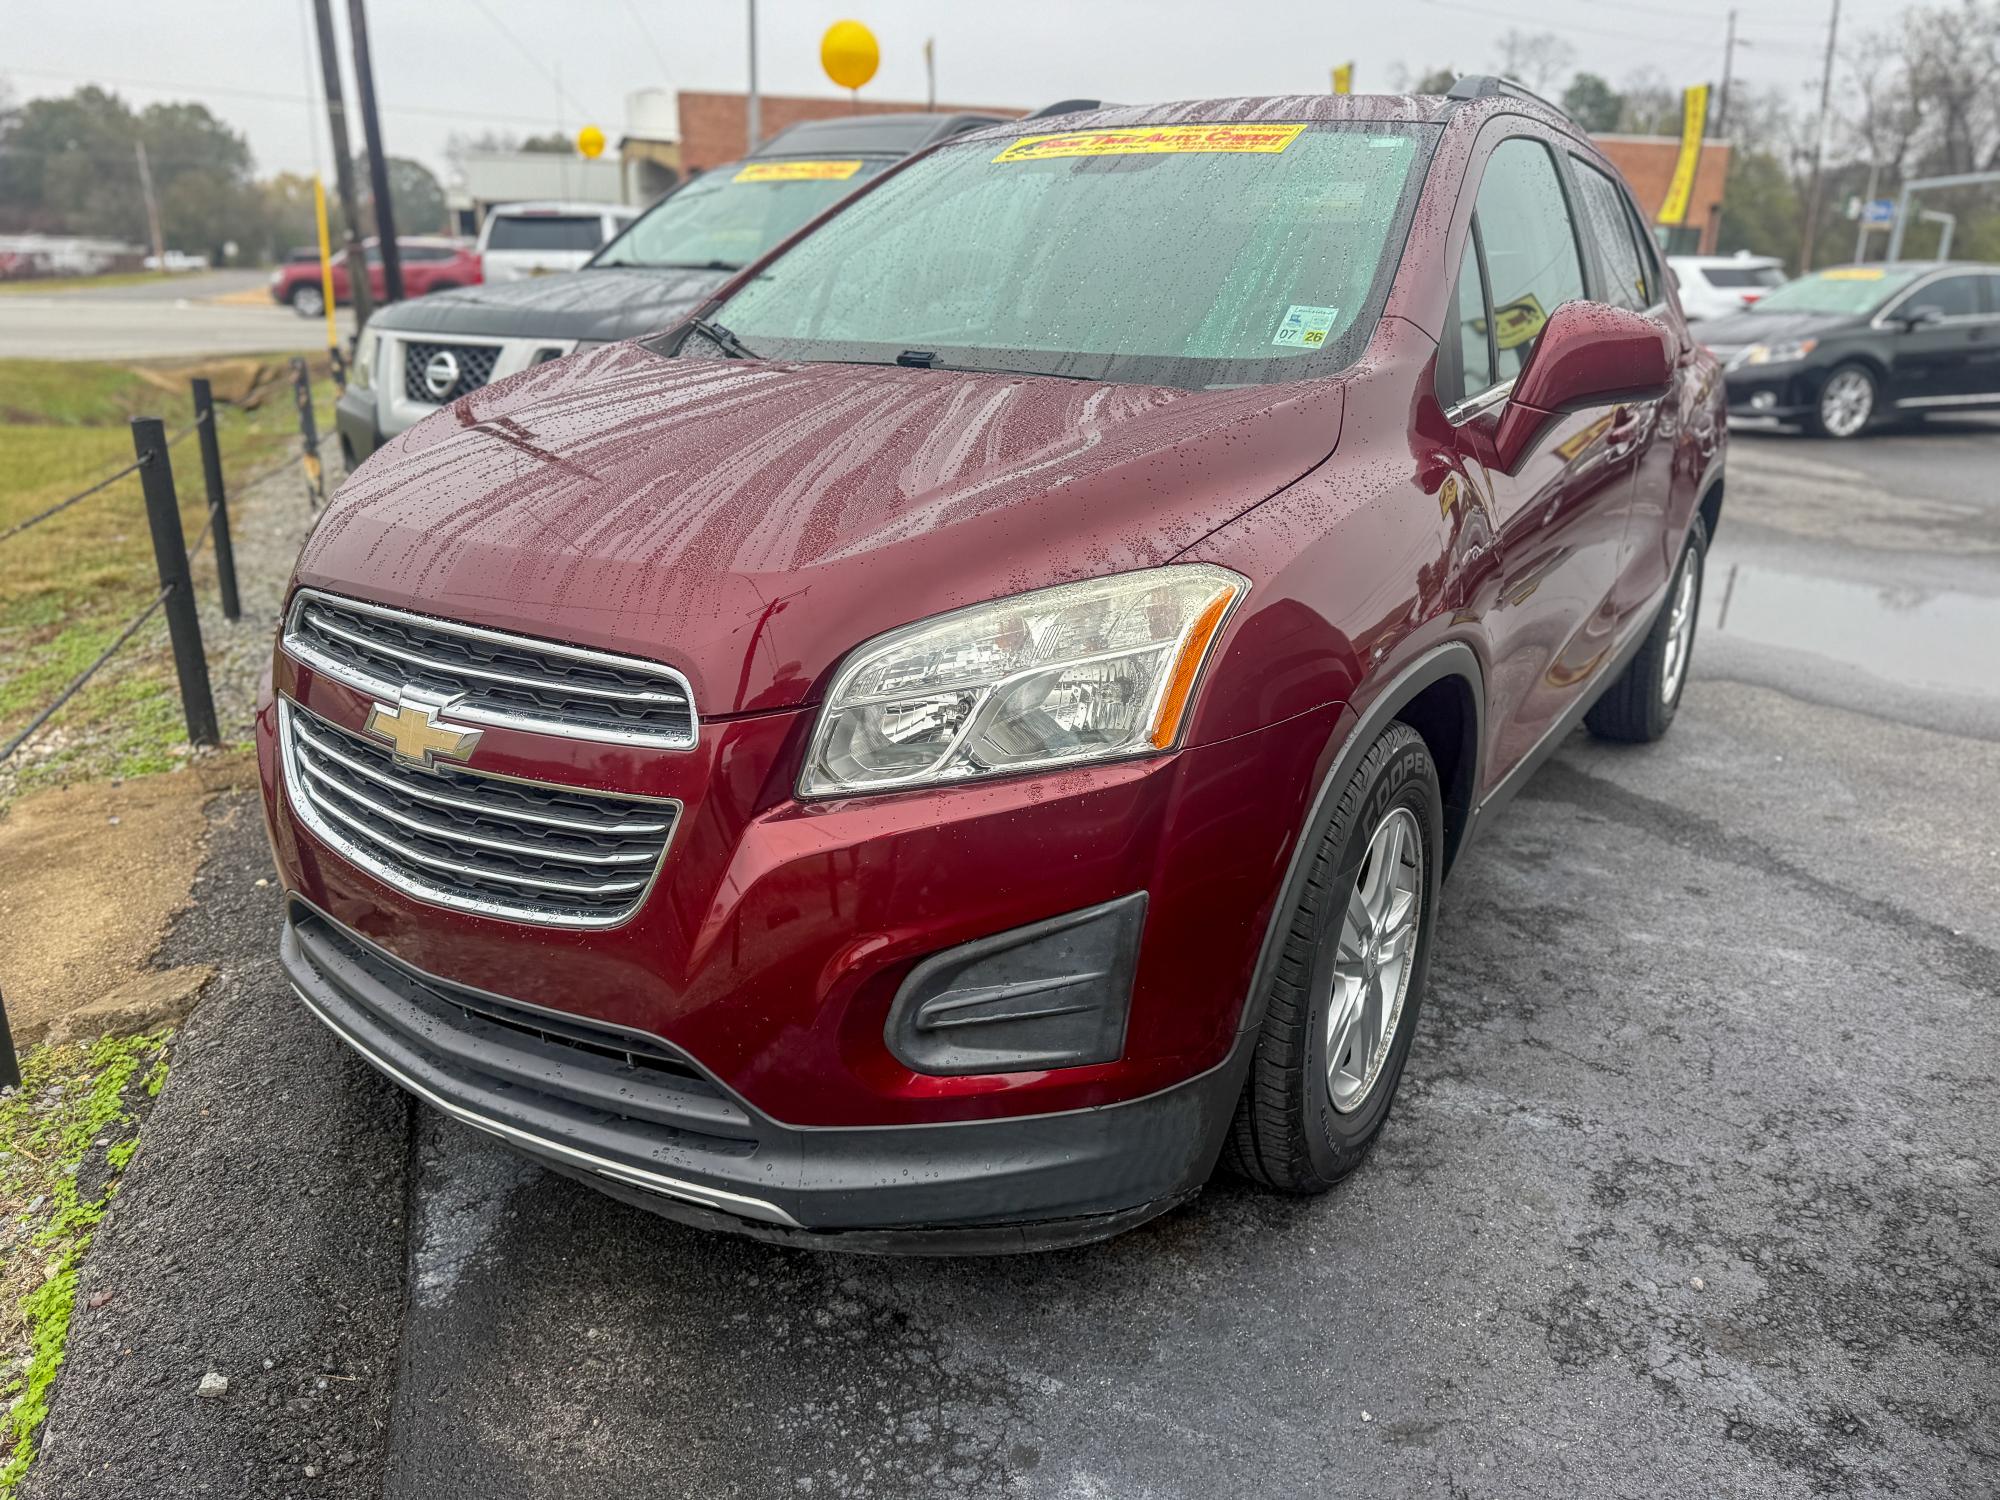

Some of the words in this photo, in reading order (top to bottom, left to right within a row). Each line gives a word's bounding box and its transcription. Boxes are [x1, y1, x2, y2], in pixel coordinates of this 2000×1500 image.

[1280, 329, 1297, 340] 07
[1304, 331, 1323, 342] 26
[1361, 752, 1434, 843] COOPER
